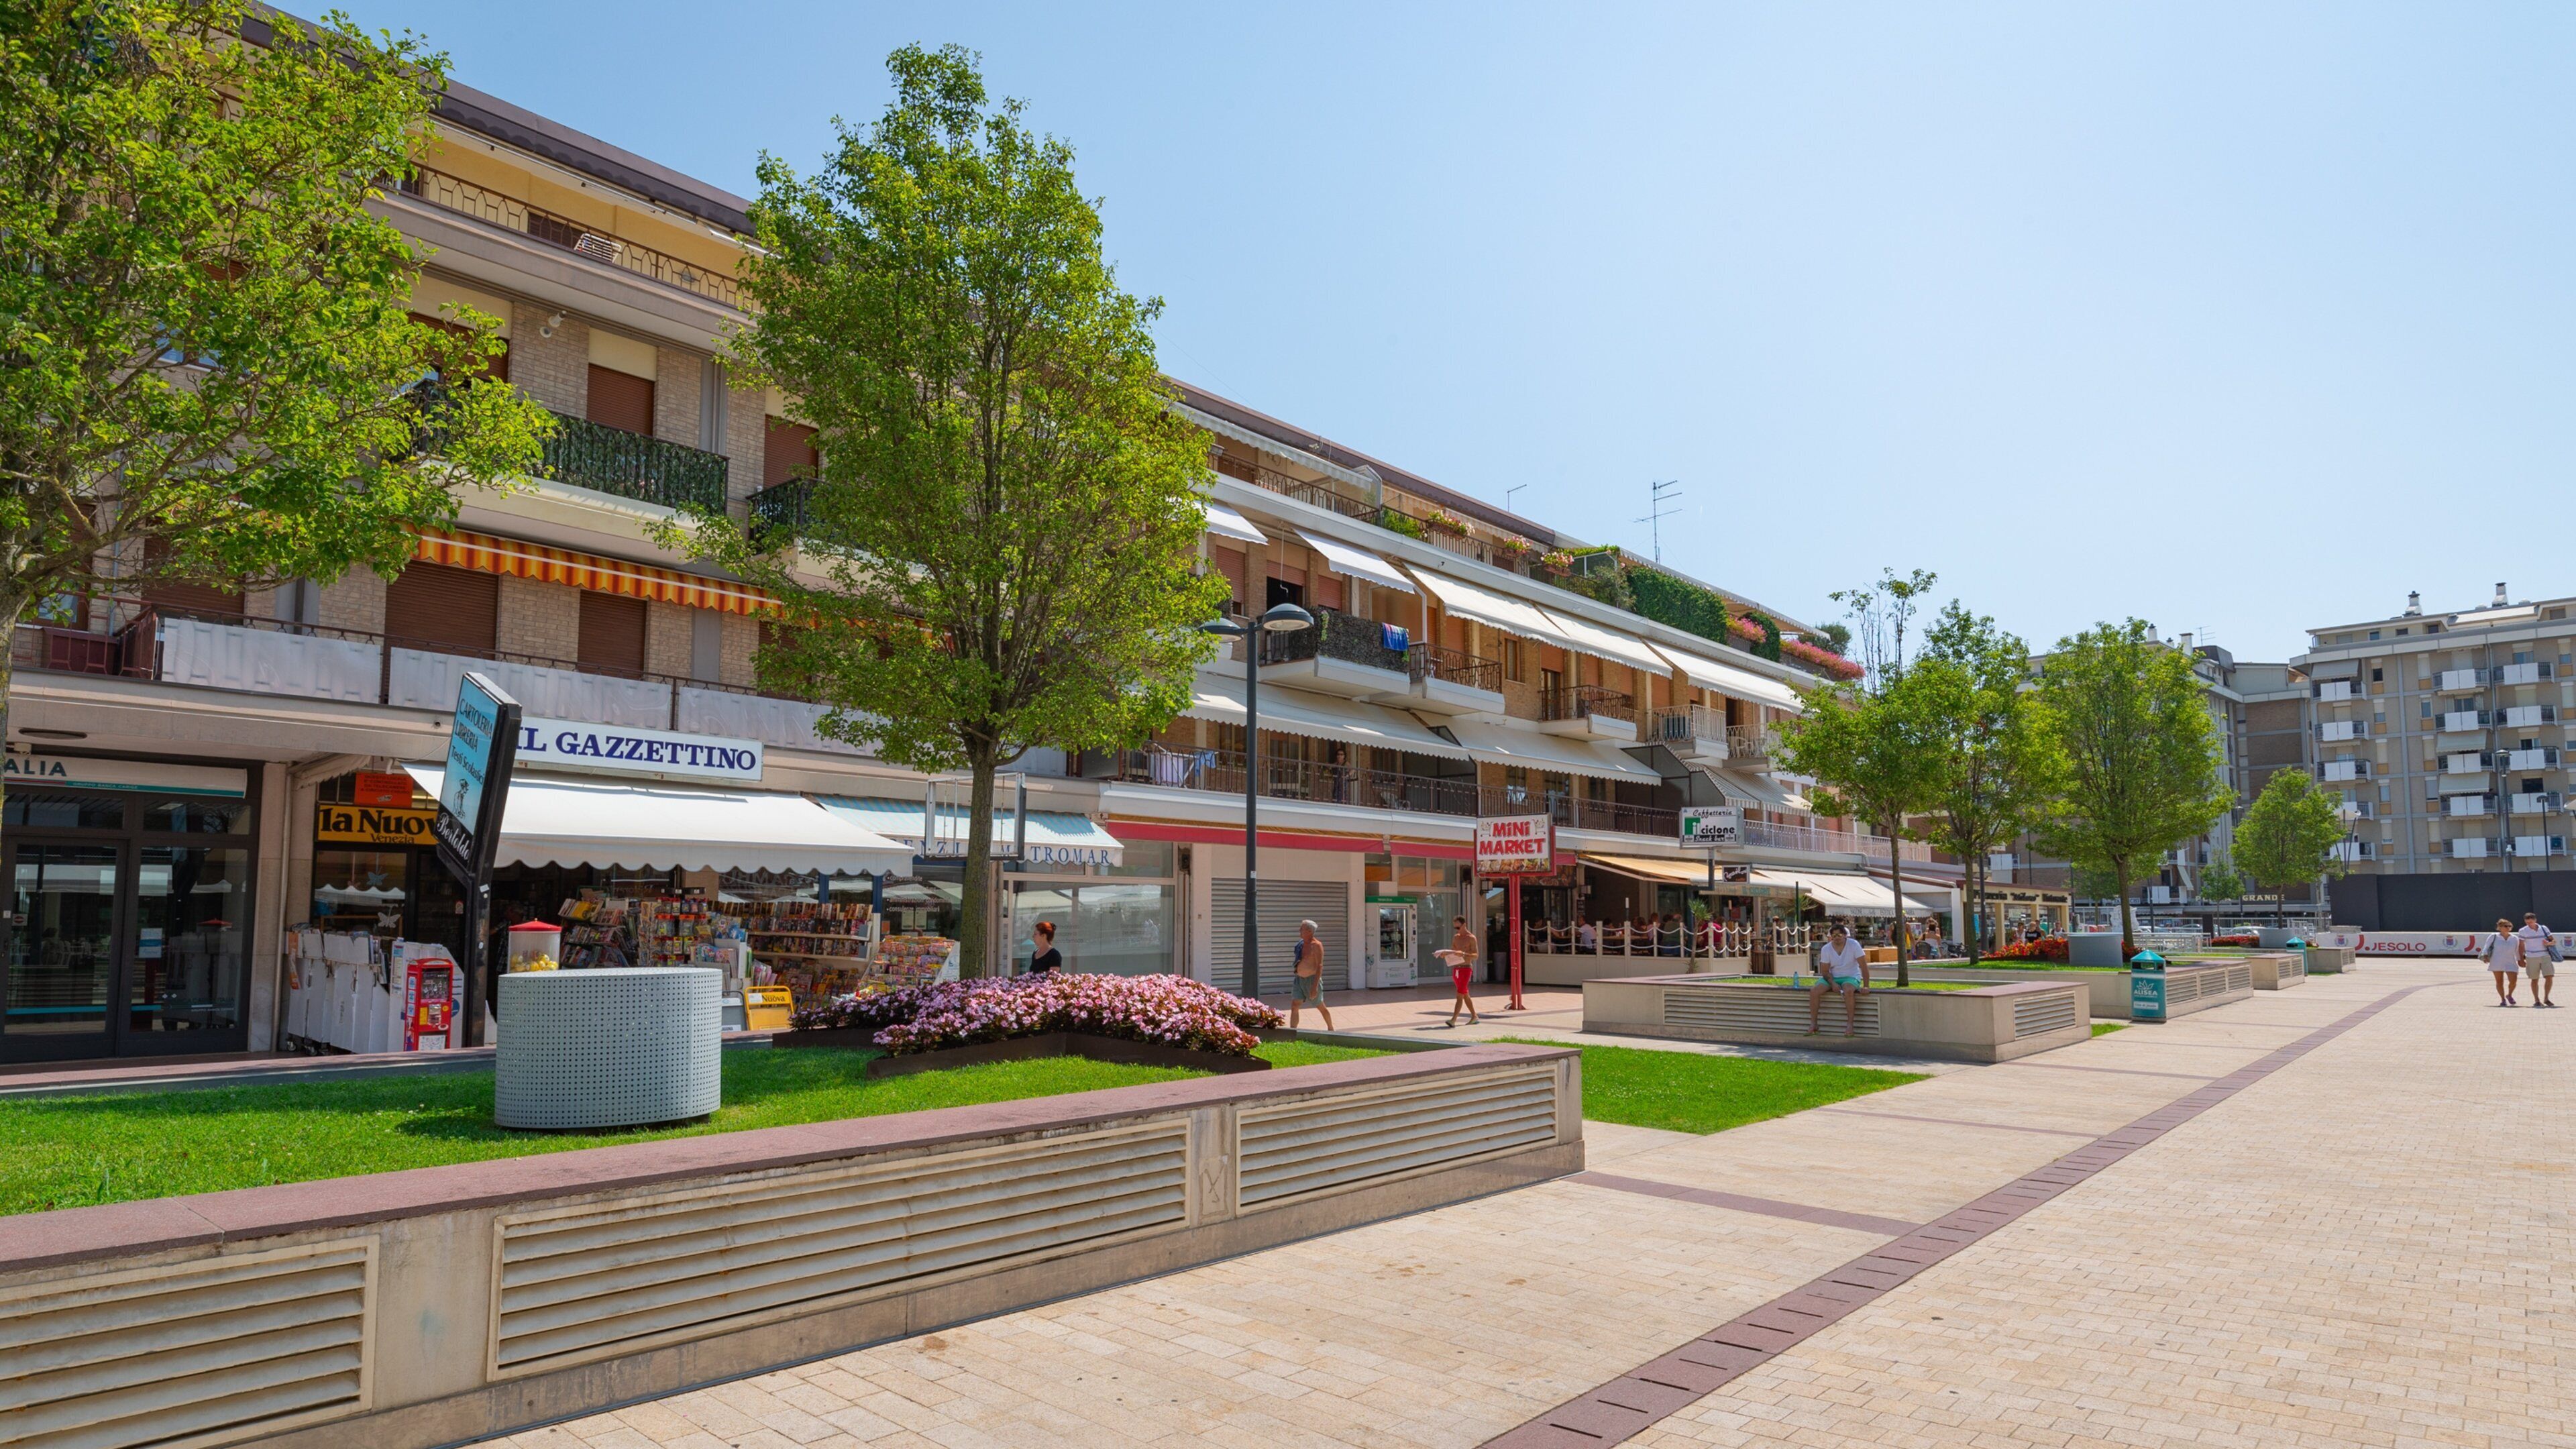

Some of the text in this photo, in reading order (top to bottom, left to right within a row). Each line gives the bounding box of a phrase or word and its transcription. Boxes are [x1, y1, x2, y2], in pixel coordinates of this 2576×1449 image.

[460, 698, 493, 738] CARTOLERIA
[454, 720, 478, 753] LIBRERIA
[555, 731, 756, 770] GAZZETTINO
[451, 745, 484, 786] Testi Scolastici
[320, 808, 436, 835] la Nuov
[1693, 809, 1733, 818] Caffetteria
[371, 833, 415, 844] Venezia
[437, 812, 470, 861] Bertoldo
[1701, 825, 1735, 834] ciclone
[1479, 838, 1546, 856] MARKET
[2372, 942, 2426, 952] JESOLO
